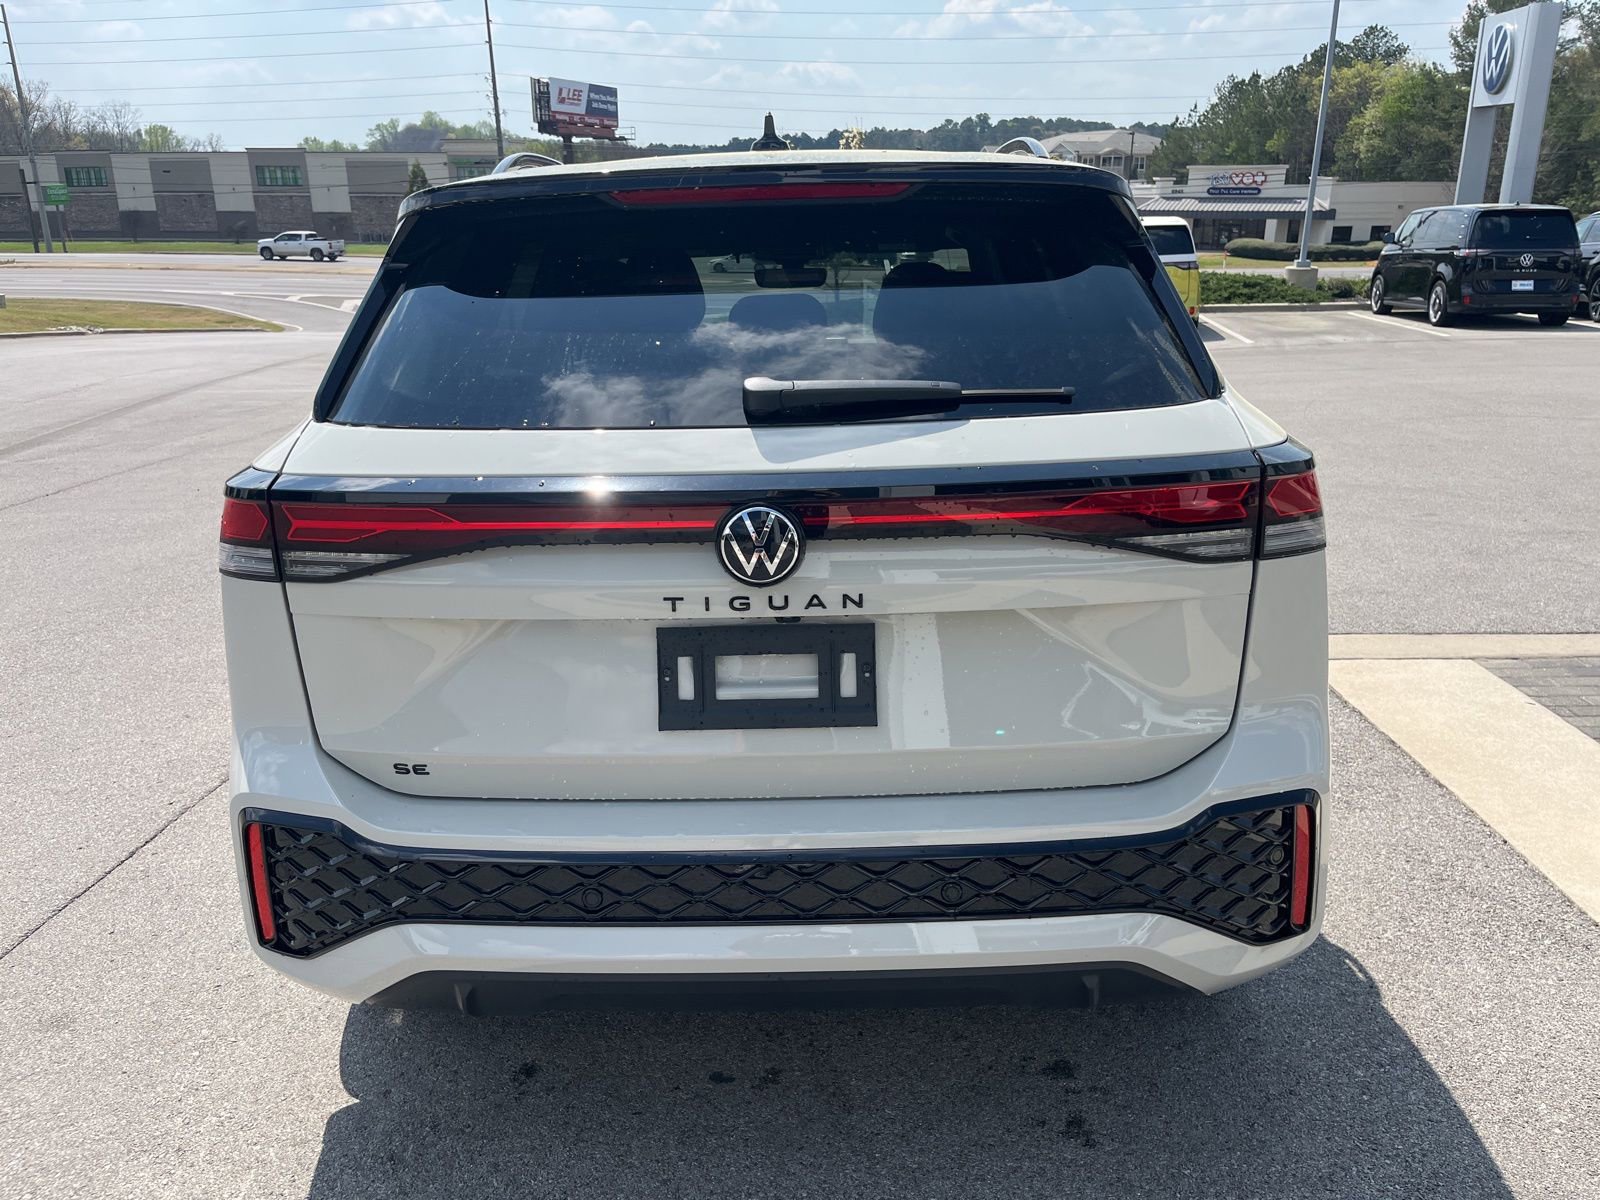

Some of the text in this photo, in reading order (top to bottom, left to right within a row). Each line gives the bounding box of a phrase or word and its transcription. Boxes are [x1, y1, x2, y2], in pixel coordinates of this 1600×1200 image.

[567, 87, 583, 100] LEE
[663, 593, 864, 613] TIGUAN
[393, 763, 431, 776] SE
